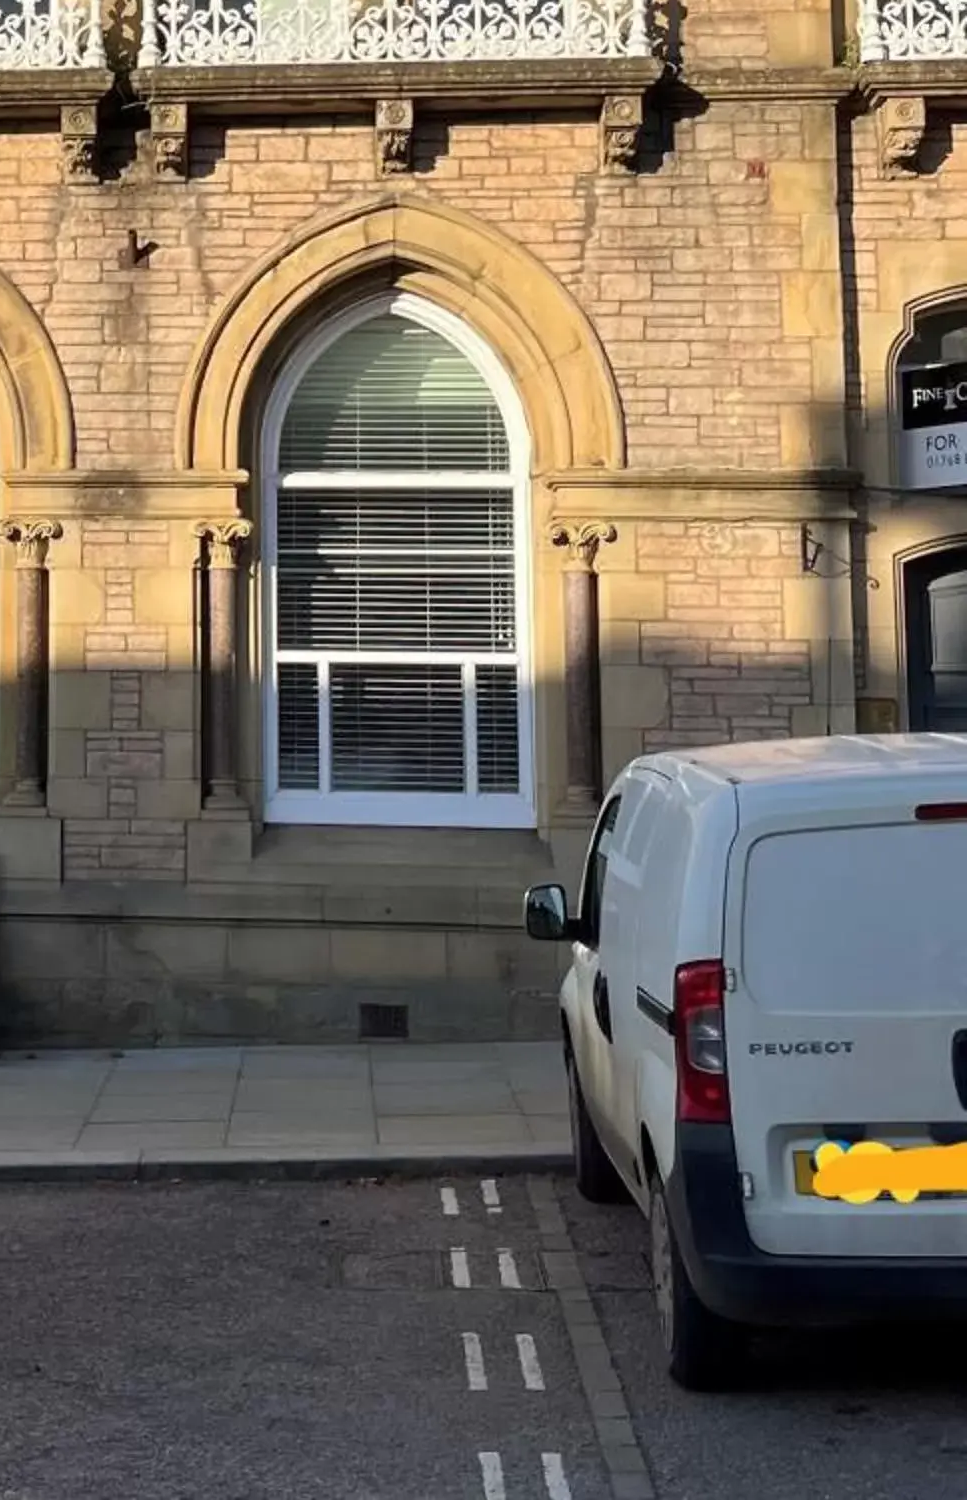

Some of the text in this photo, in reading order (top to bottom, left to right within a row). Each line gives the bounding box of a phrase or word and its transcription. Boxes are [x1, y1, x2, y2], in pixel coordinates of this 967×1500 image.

[912, 387, 944, 409] FINE
[926, 433, 958, 452] FOR
[748, 1041, 854, 1055] PEUGEOT
